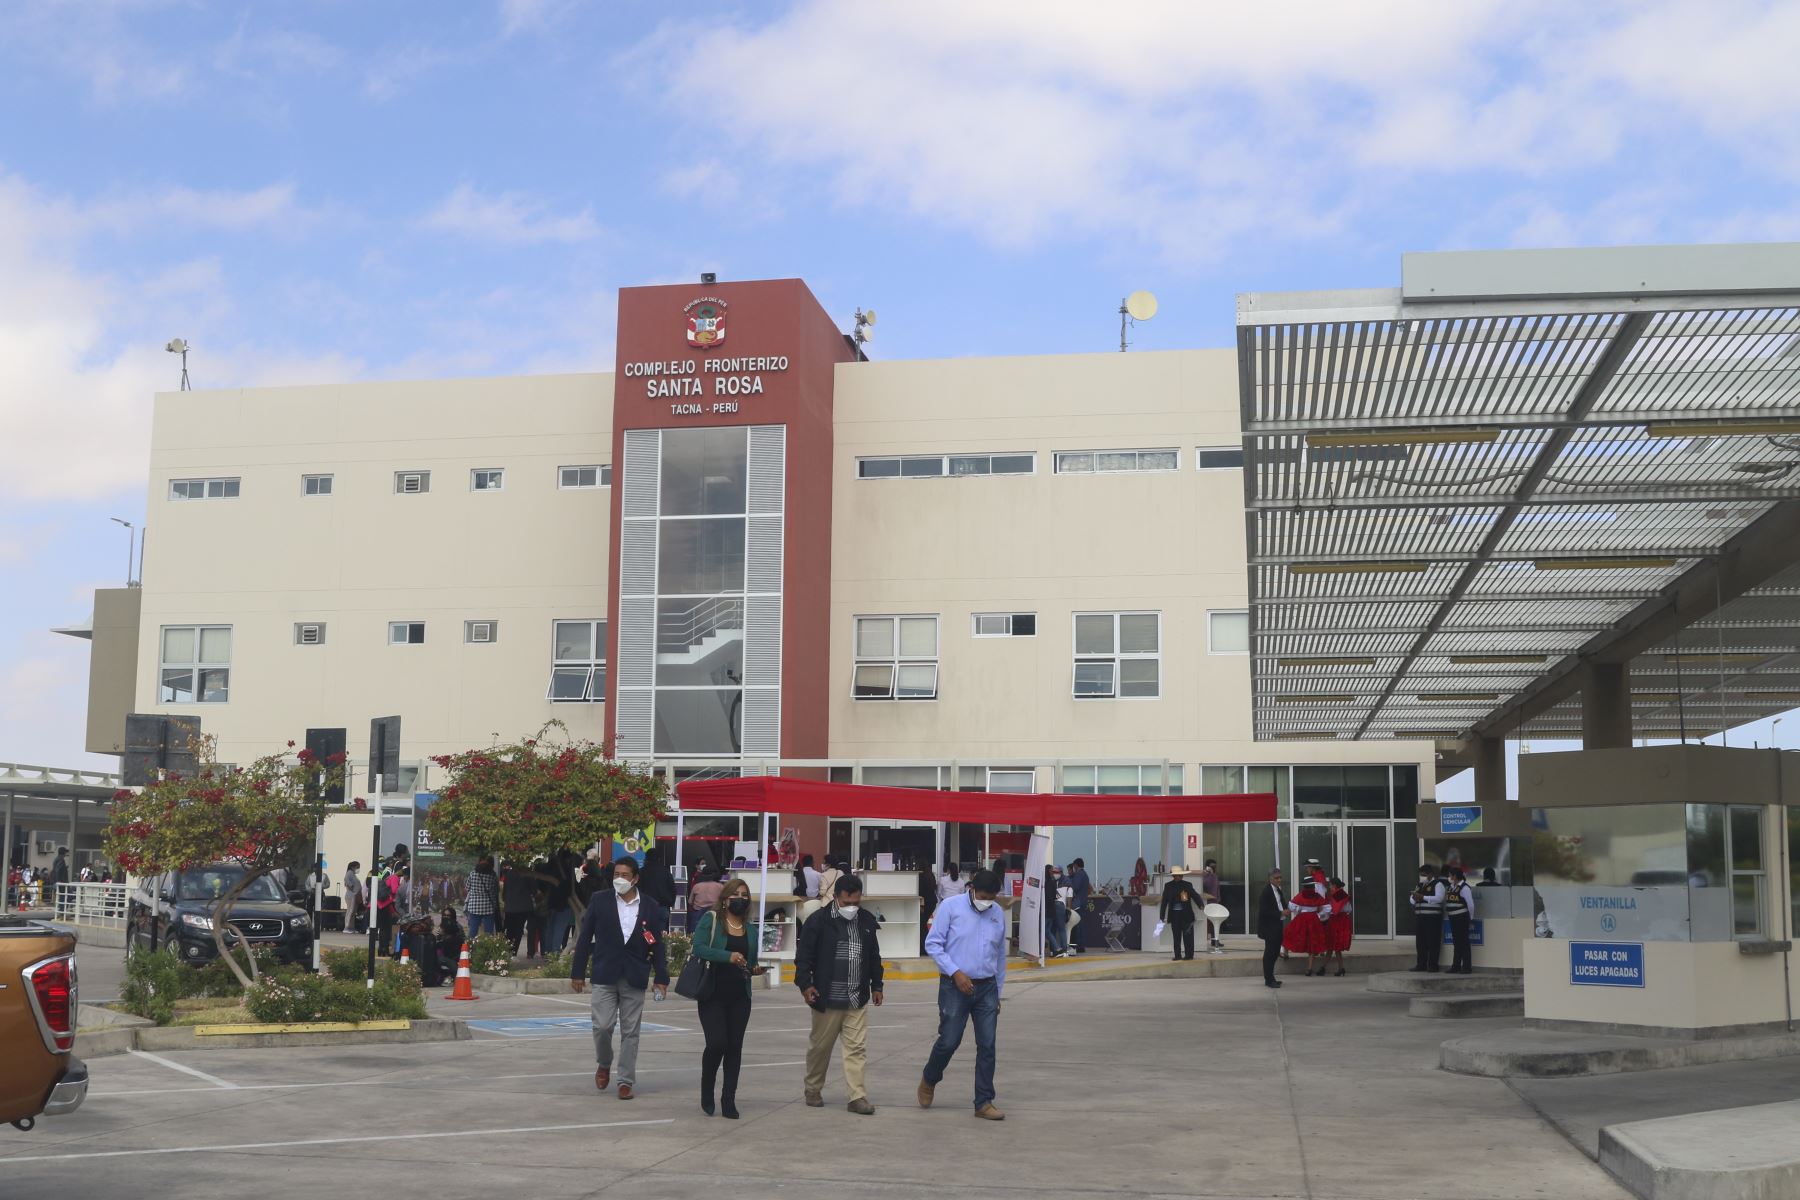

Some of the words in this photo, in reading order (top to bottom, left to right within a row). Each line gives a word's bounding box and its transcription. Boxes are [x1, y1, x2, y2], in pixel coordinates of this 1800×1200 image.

[625, 360, 695, 376] COMPLEJO
[704, 356, 788, 372] FRONTERIZO
[647, 378, 702, 397] SANTA
[715, 376, 763, 395] ROSA
[671, 403, 702, 415] TACNA
[713, 400, 738, 413] PERÚ
[1580, 896, 1637, 909] VENTANILLA
[1603, 917, 1614, 929] 1A
[1584, 950, 1608, 960] PASAR
[1612, 951, 1627, 961] CON
[1575, 965, 1598, 975] LUCES
[1600, 966, 1639, 977] APAGADAS
